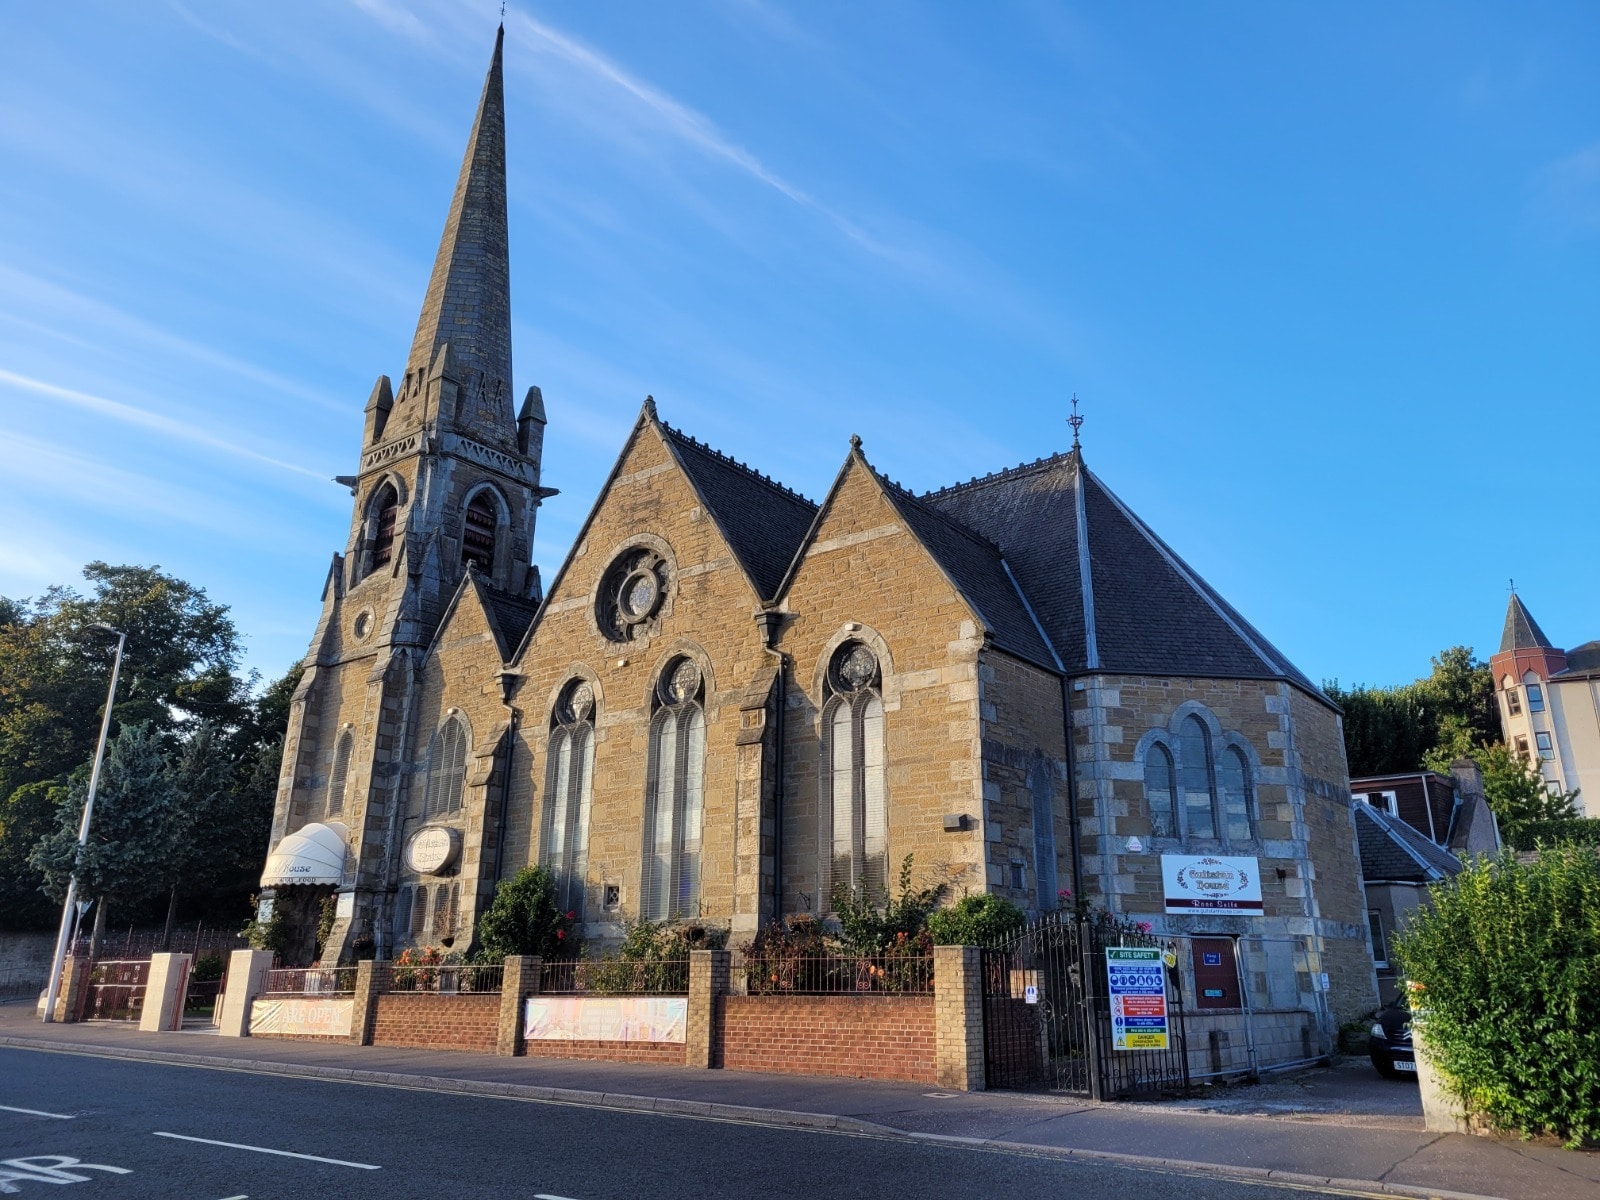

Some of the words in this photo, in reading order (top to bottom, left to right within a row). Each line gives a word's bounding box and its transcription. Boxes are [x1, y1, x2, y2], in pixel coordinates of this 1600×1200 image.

[1119, 951, 1132, 959] SITE
[1132, 951, 1154, 959] SAFETY
[282, 1007, 306, 1023] ARE
[307, 1007, 343, 1024] OPEN
